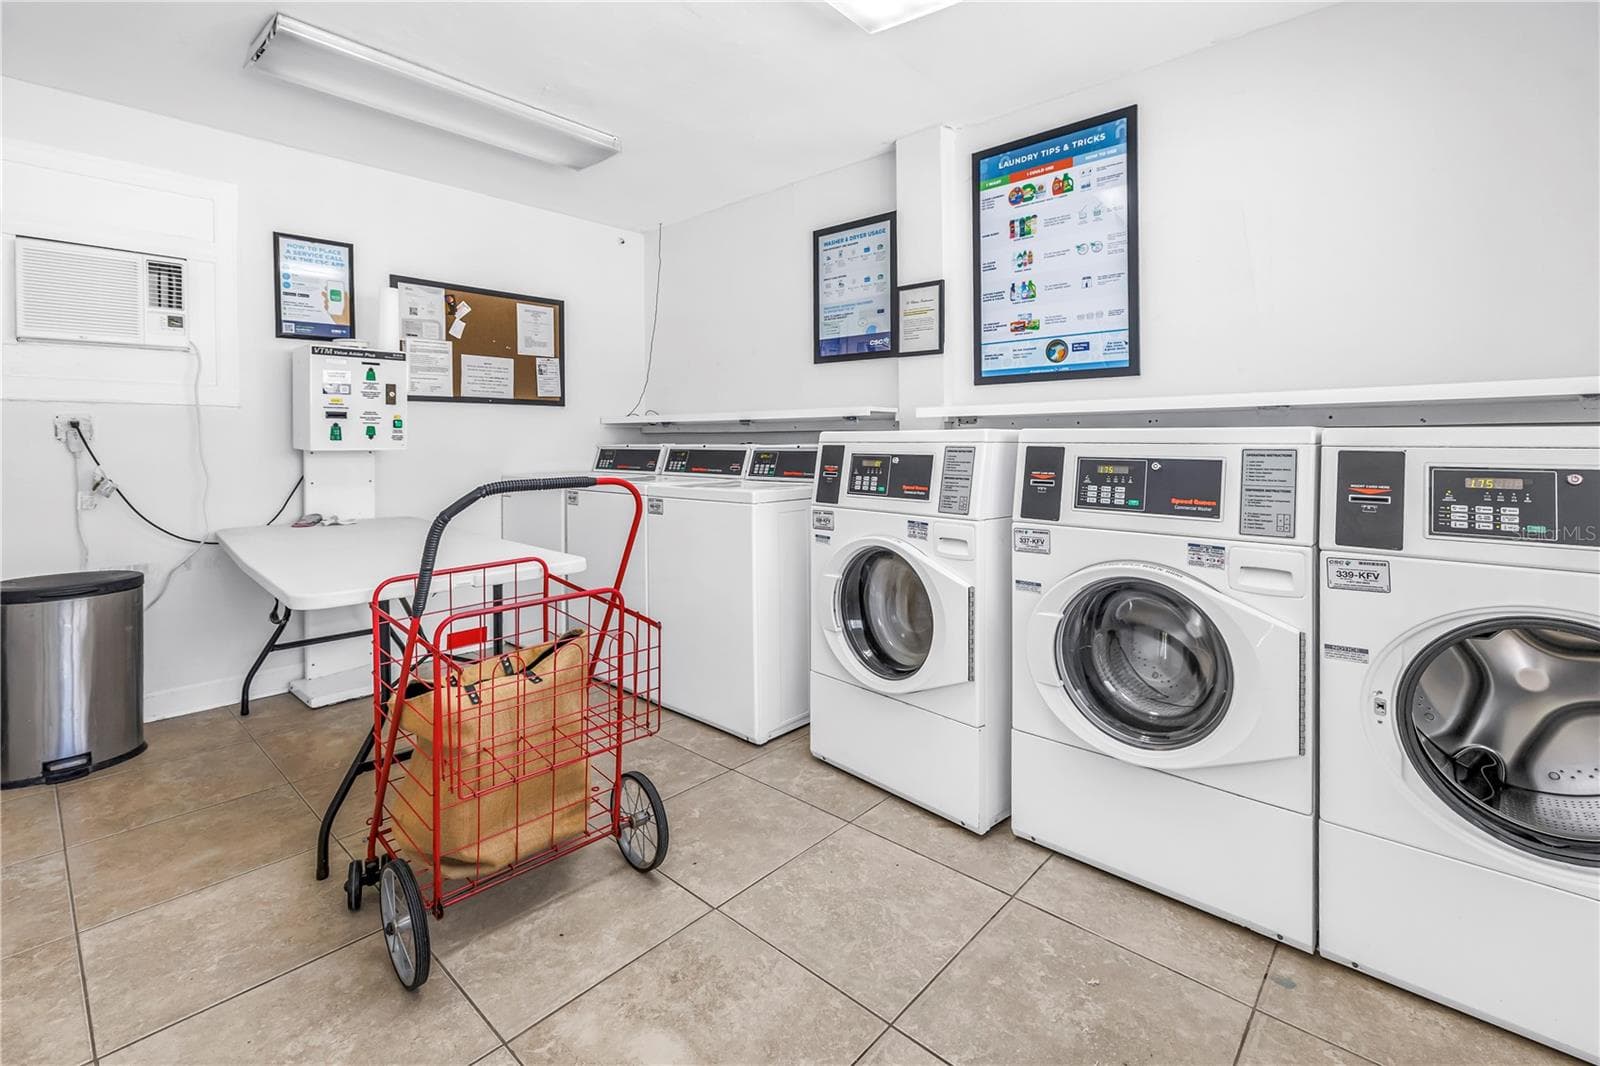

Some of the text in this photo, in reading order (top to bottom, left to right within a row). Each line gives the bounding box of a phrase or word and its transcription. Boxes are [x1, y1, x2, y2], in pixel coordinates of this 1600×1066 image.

[998, 152, 1039, 170] LAUNDRY
[1040, 146, 1061, 157] TIPS
[1072, 132, 1106, 149] TRICKS
[824, 238, 844, 247] WASHER
[849, 232, 867, 241] DRYER
[868, 228, 886, 237] USAGE
[293, 250, 324, 259] SERVICE
[319, 247, 341, 256] PLACE
[313, 347, 333, 355] VTM
[1336, 570, 1380, 580] 339-KFV
